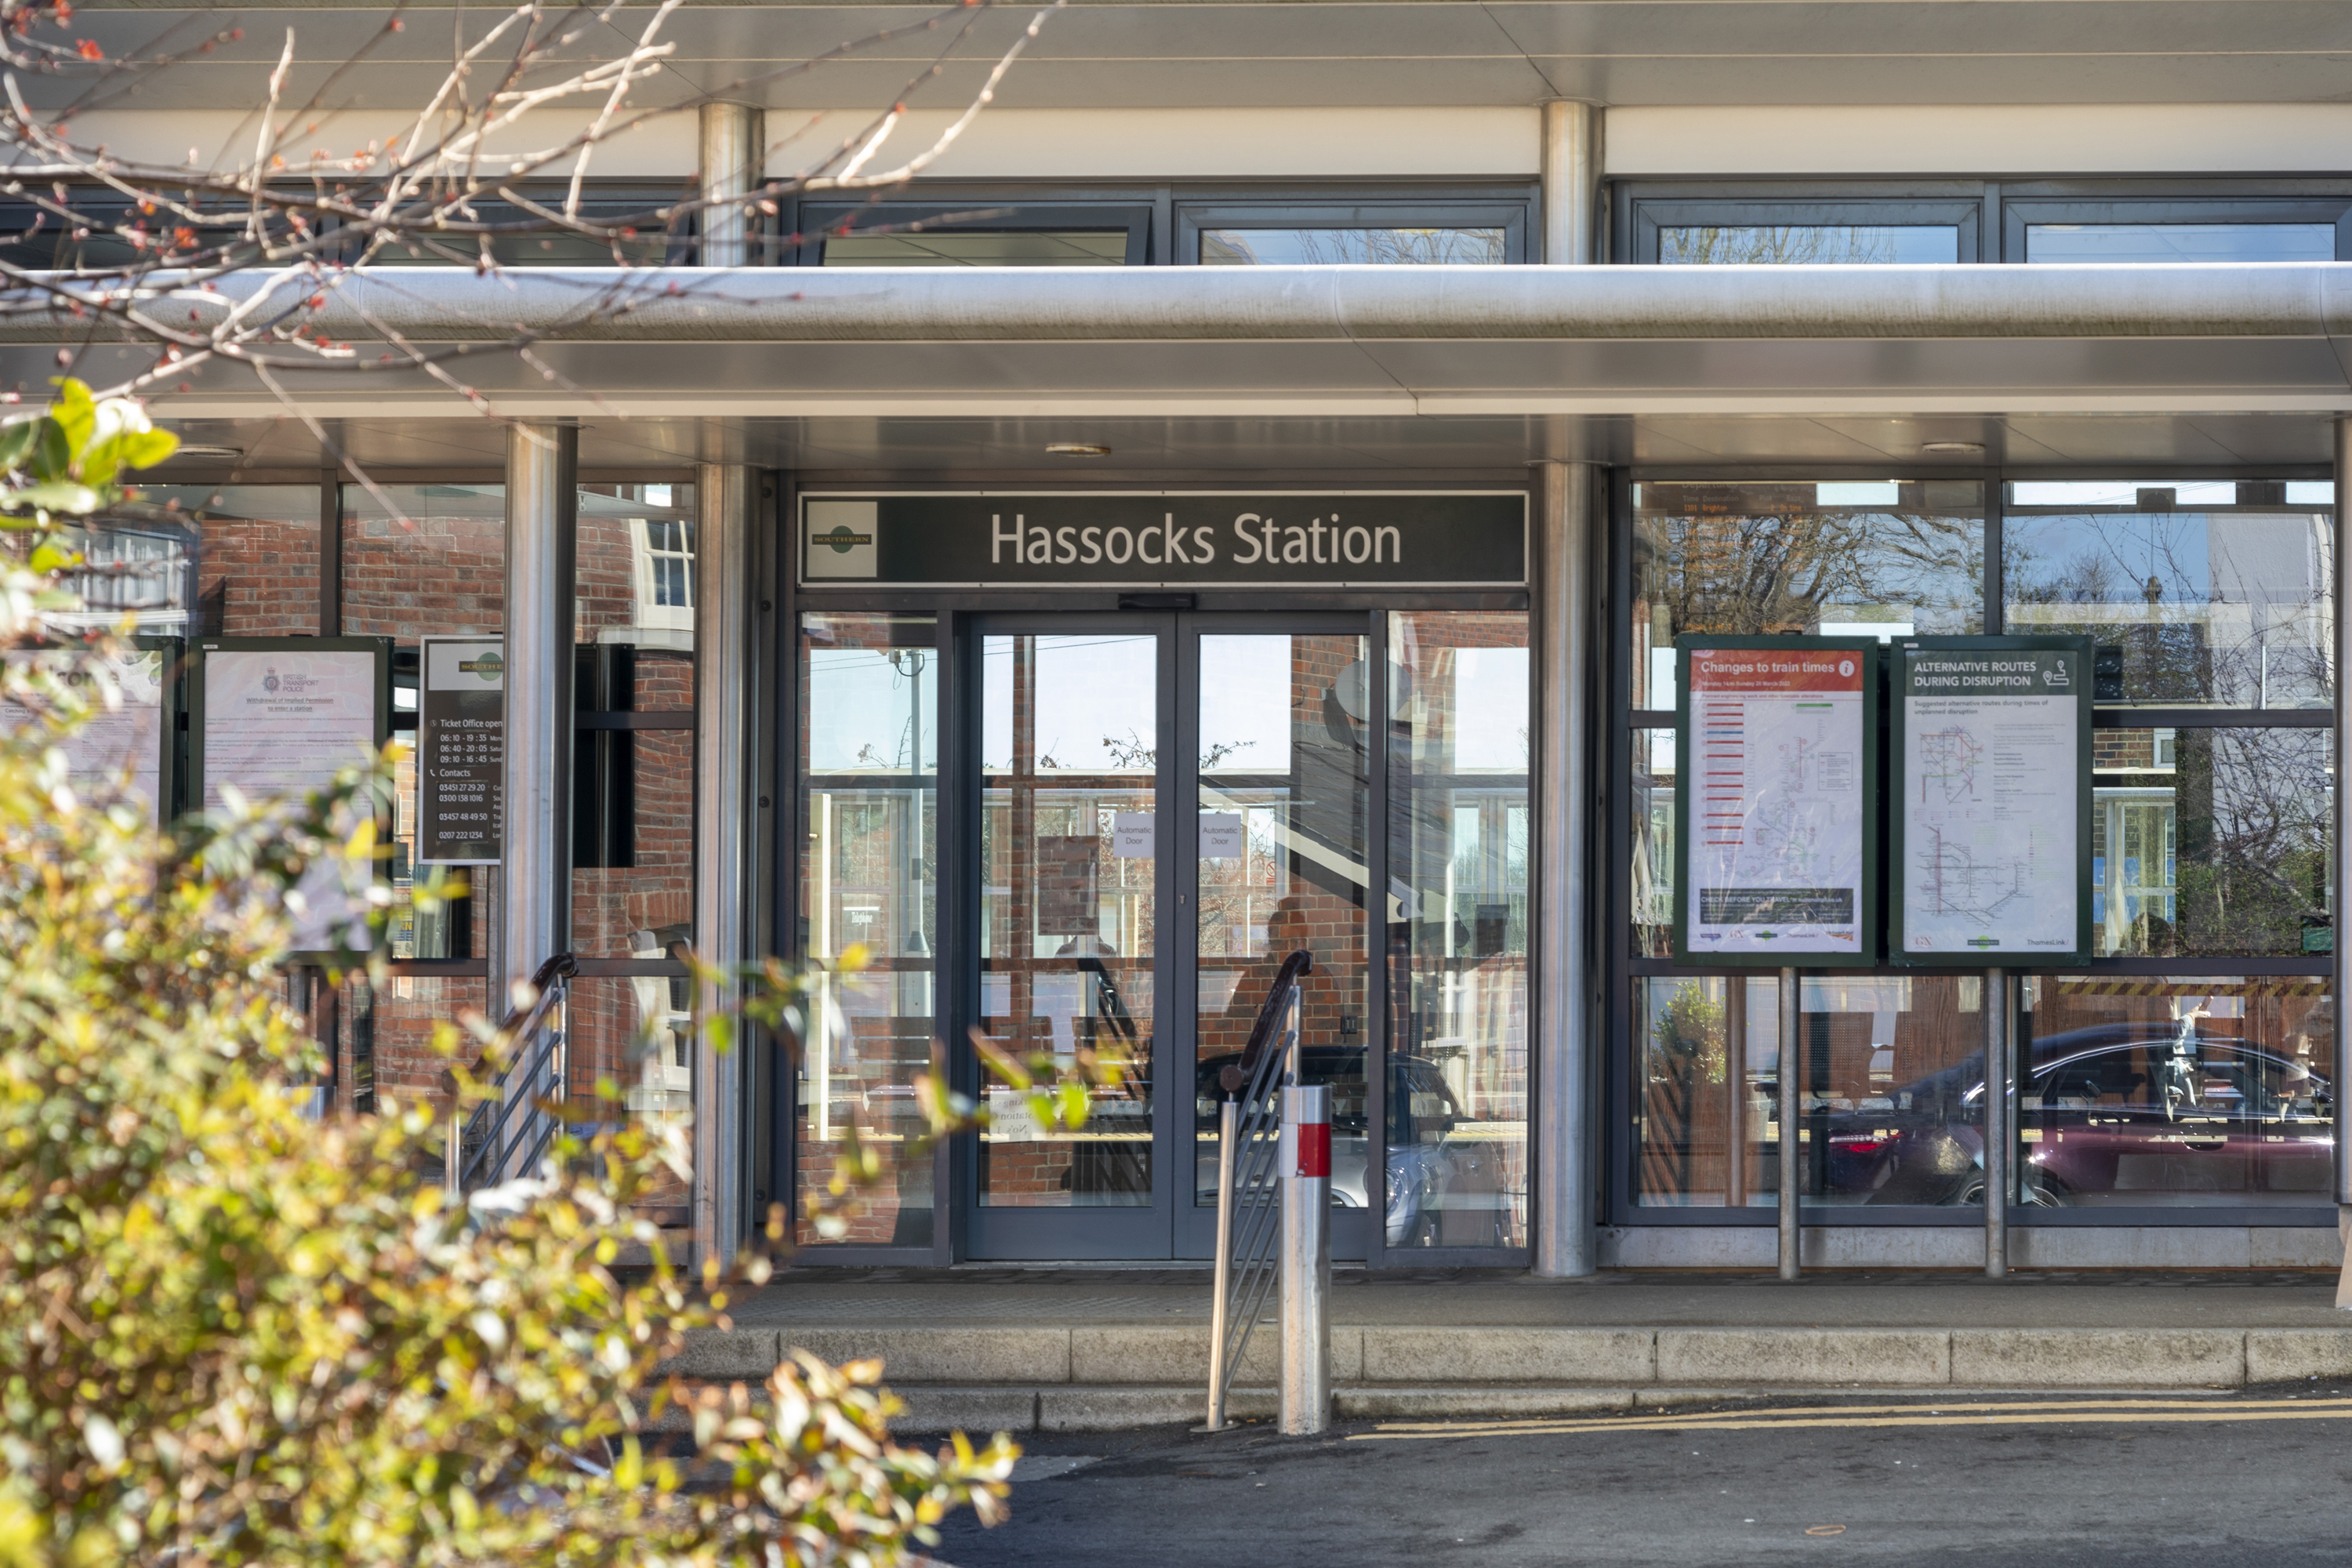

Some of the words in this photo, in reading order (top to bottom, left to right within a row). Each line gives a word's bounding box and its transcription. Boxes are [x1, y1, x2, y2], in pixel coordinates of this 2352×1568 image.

[1702, 504, 1728, 514] Brighton
[992, 513, 1214, 564] Hassocks
[1233, 513, 1401, 564] Station
[1700, 662, 1754, 675] Changes
[1757, 662, 1769, 673] to
[1772, 662, 1799, 673] train
[1802, 662, 1835, 673] times
[1914, 662, 1989, 672] ALTERNATIVE
[1991, 662, 2036, 672] ROUTES
[1914, 676, 1959, 687] DURING
[1962, 676, 2031, 686] DISRUPTION
[440, 719, 461, 728] Ticket
[463, 719, 484, 728] Office
[439, 768, 470, 777] Contacts
